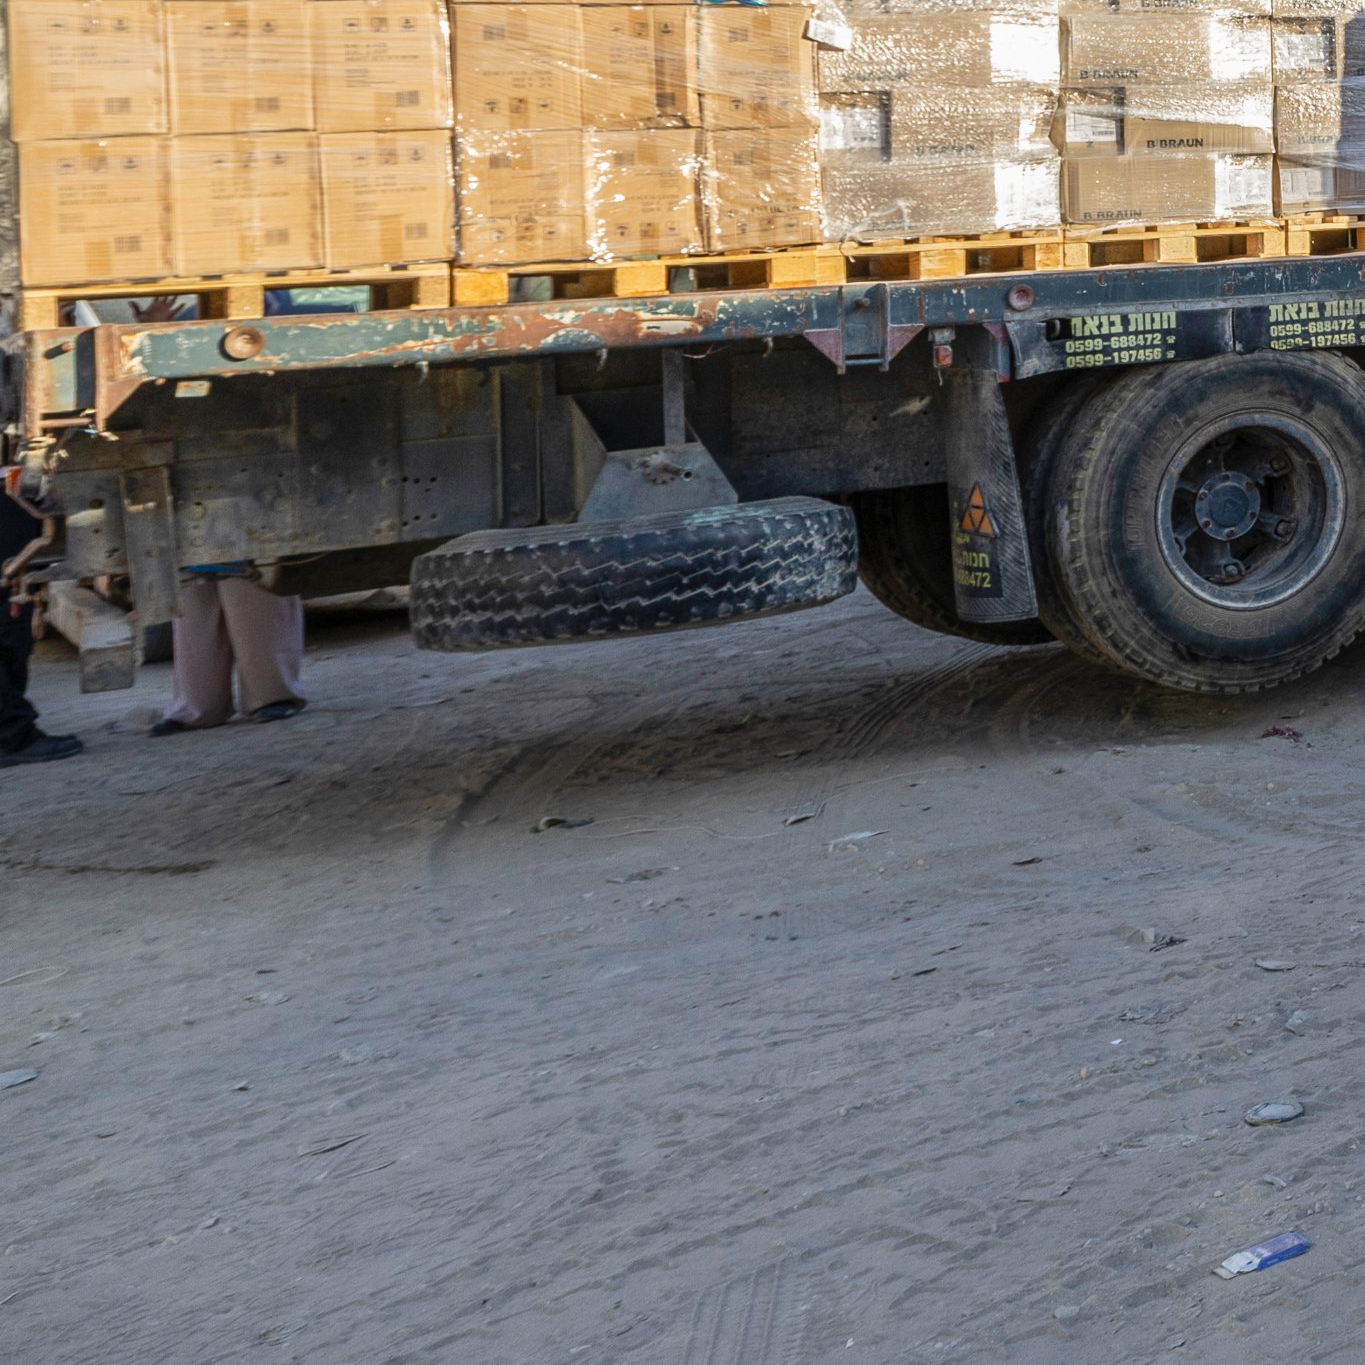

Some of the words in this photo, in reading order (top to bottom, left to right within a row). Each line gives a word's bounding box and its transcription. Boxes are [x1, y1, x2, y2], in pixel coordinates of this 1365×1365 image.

[1160, 138, 1204, 149] BRAUN
[1128, 311, 1177, 332] חנות
[1268, 302, 1320, 322] בנאת
[1270, 319, 1355, 337] 0599-688472
[1065, 333, 1162, 353] 0599-688472
[1270, 333, 1356, 350] 0599-197456
[1066, 348, 1162, 368] 0599-197456
